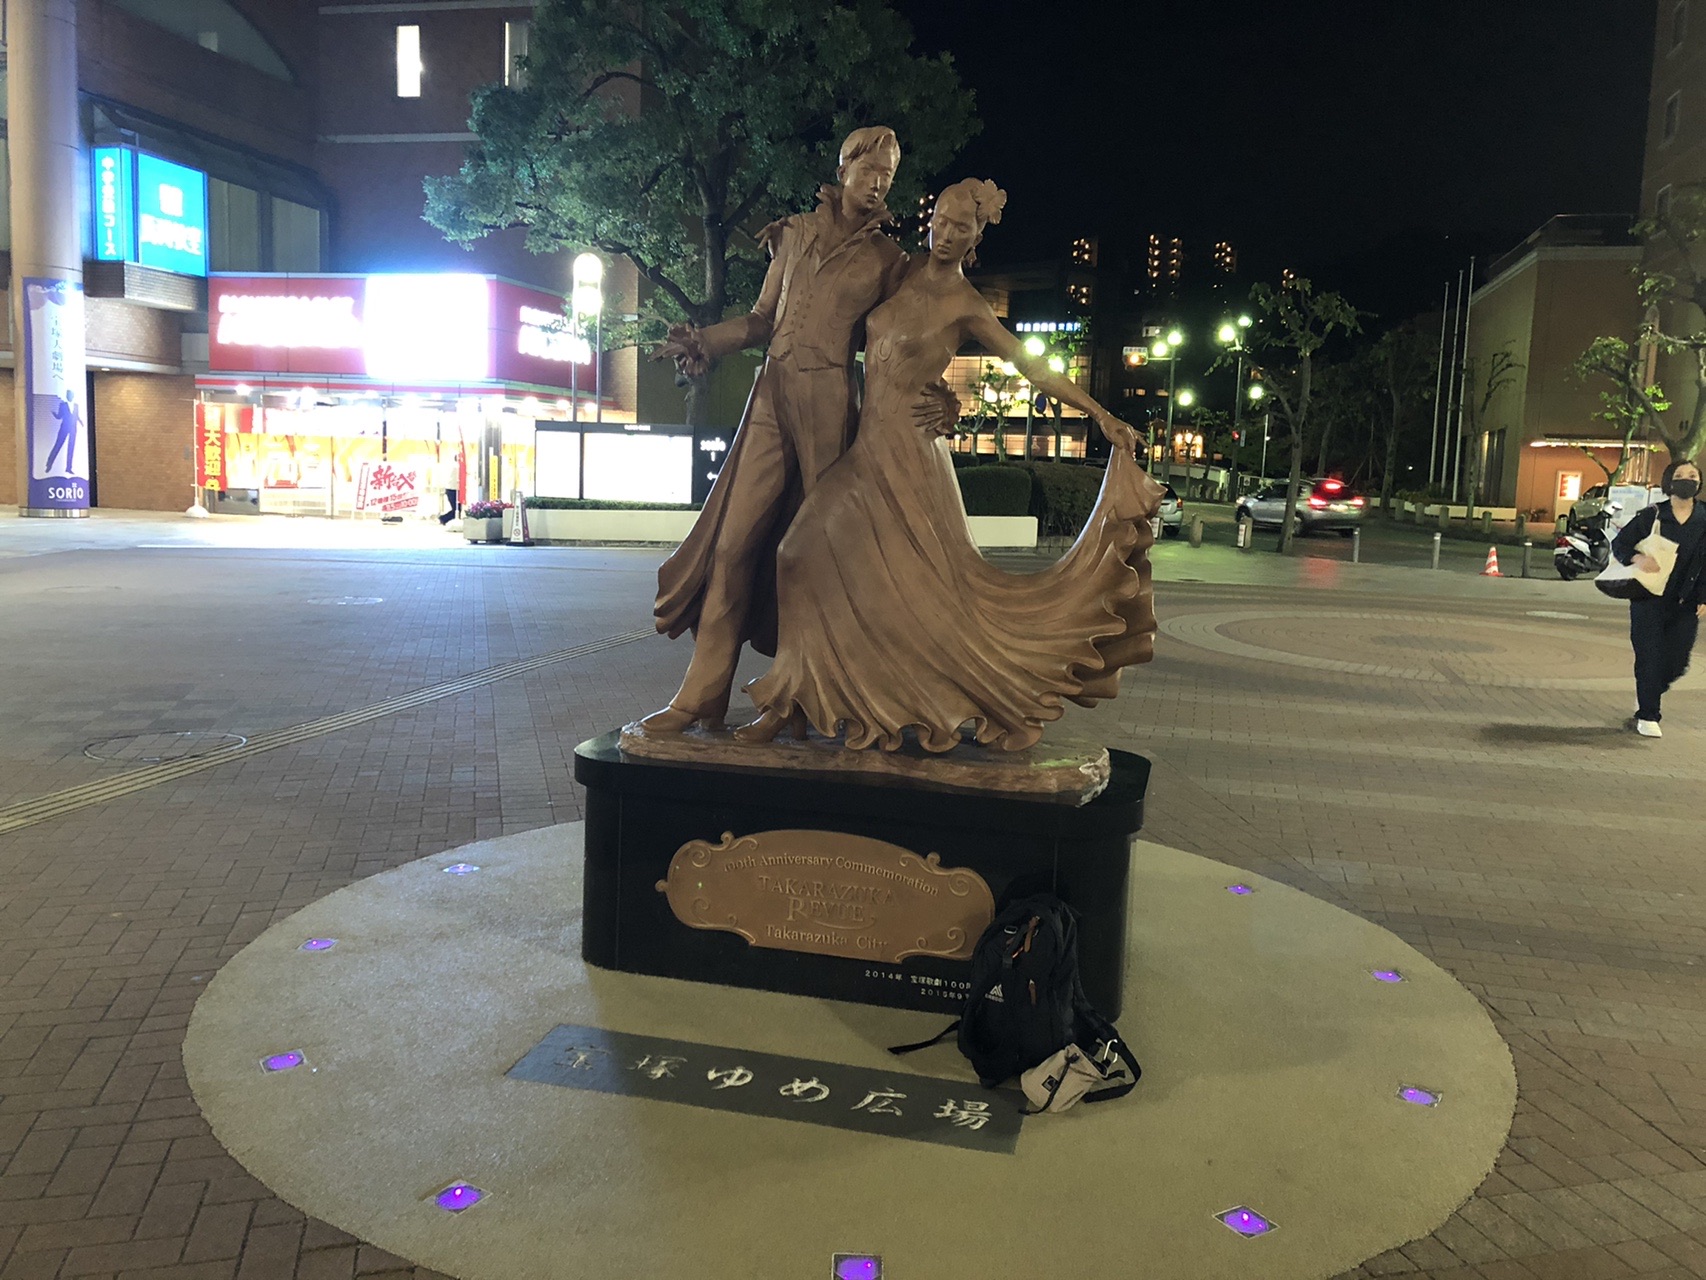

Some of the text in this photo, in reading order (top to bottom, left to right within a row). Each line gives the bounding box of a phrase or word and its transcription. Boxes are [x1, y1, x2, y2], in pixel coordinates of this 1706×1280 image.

[48, 482, 84, 499] SORIO
[760, 853, 833, 870] Anniversary
[835, 856, 939, 896] Commemoration
[758, 875, 898, 905] TAKARAZUKA
[766, 924, 847, 946] Takarazuka
[864, 969, 903, 982] 2014年
[554, 1044, 992, 1131] 宝塚ゆめ広場
